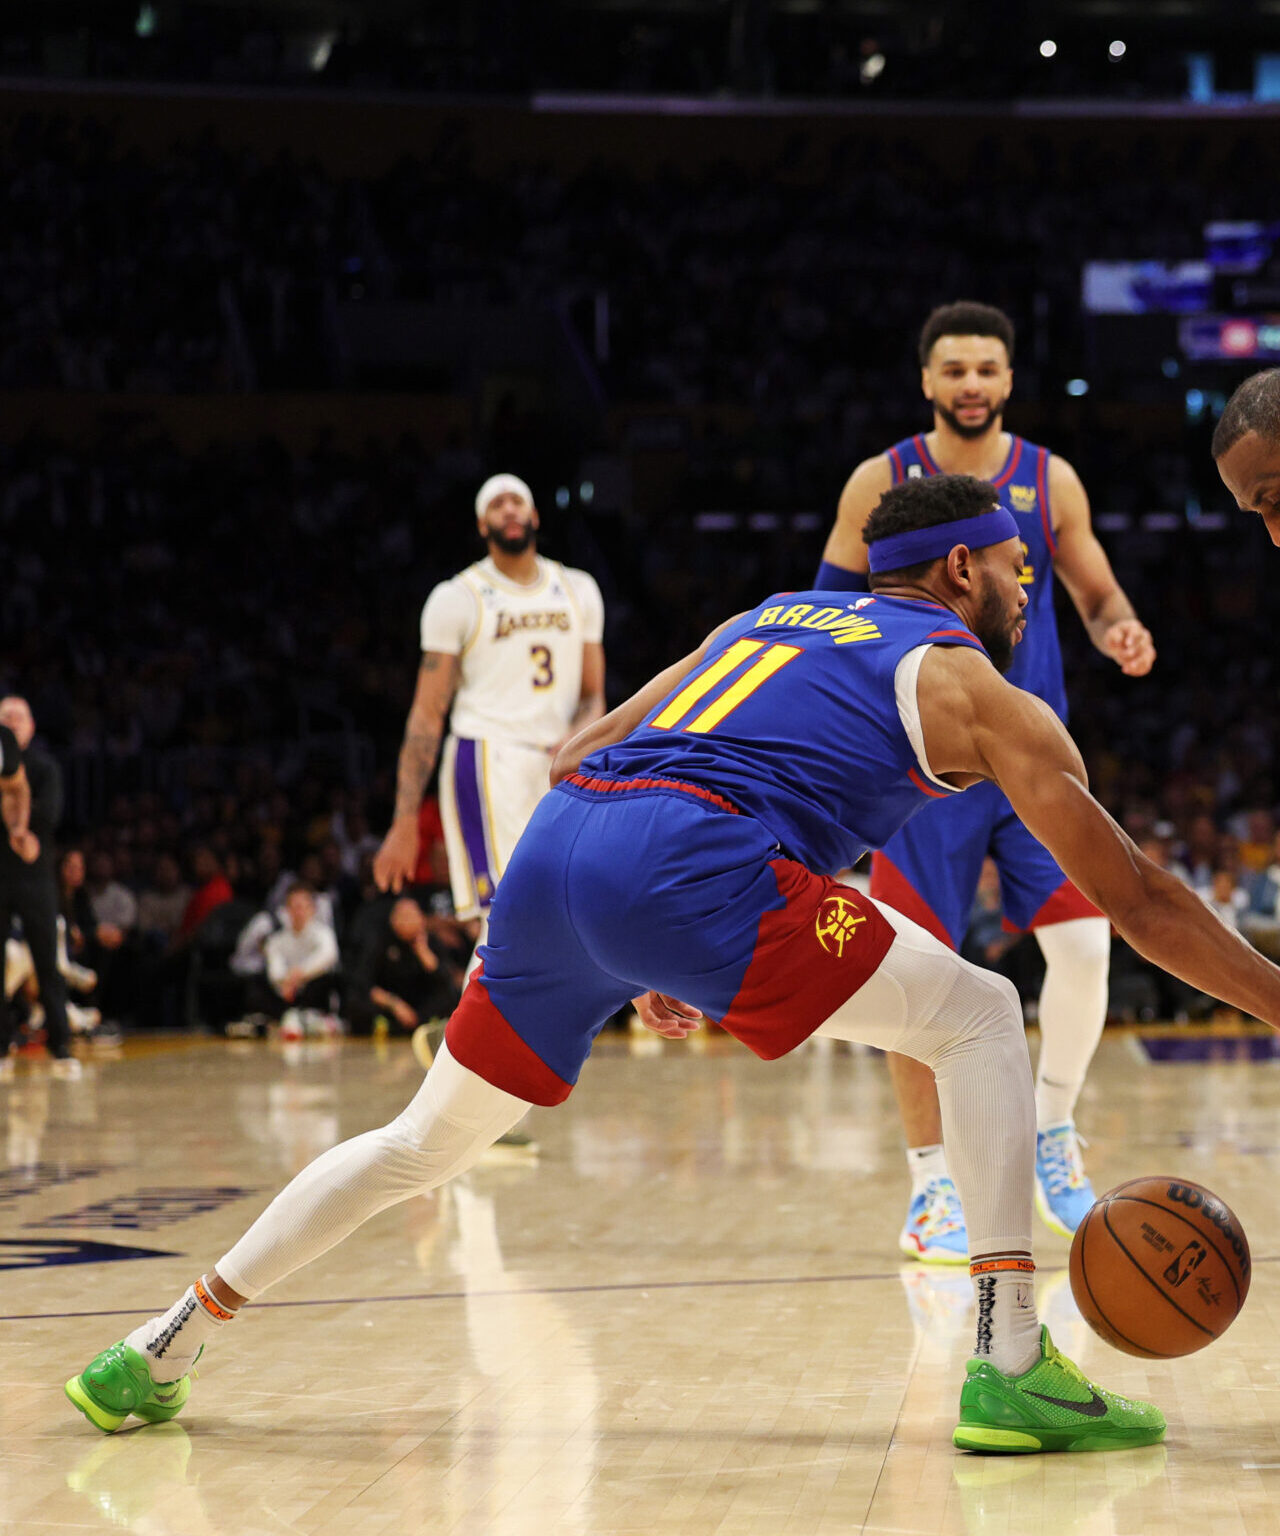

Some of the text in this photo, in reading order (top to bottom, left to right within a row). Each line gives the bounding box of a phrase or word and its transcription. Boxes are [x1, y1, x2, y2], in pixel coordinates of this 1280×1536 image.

[493, 609, 571, 643] LAKERS
[754, 604, 882, 645] BROWN
[530, 644, 555, 691] 3
[647, 637, 805, 733] 11
